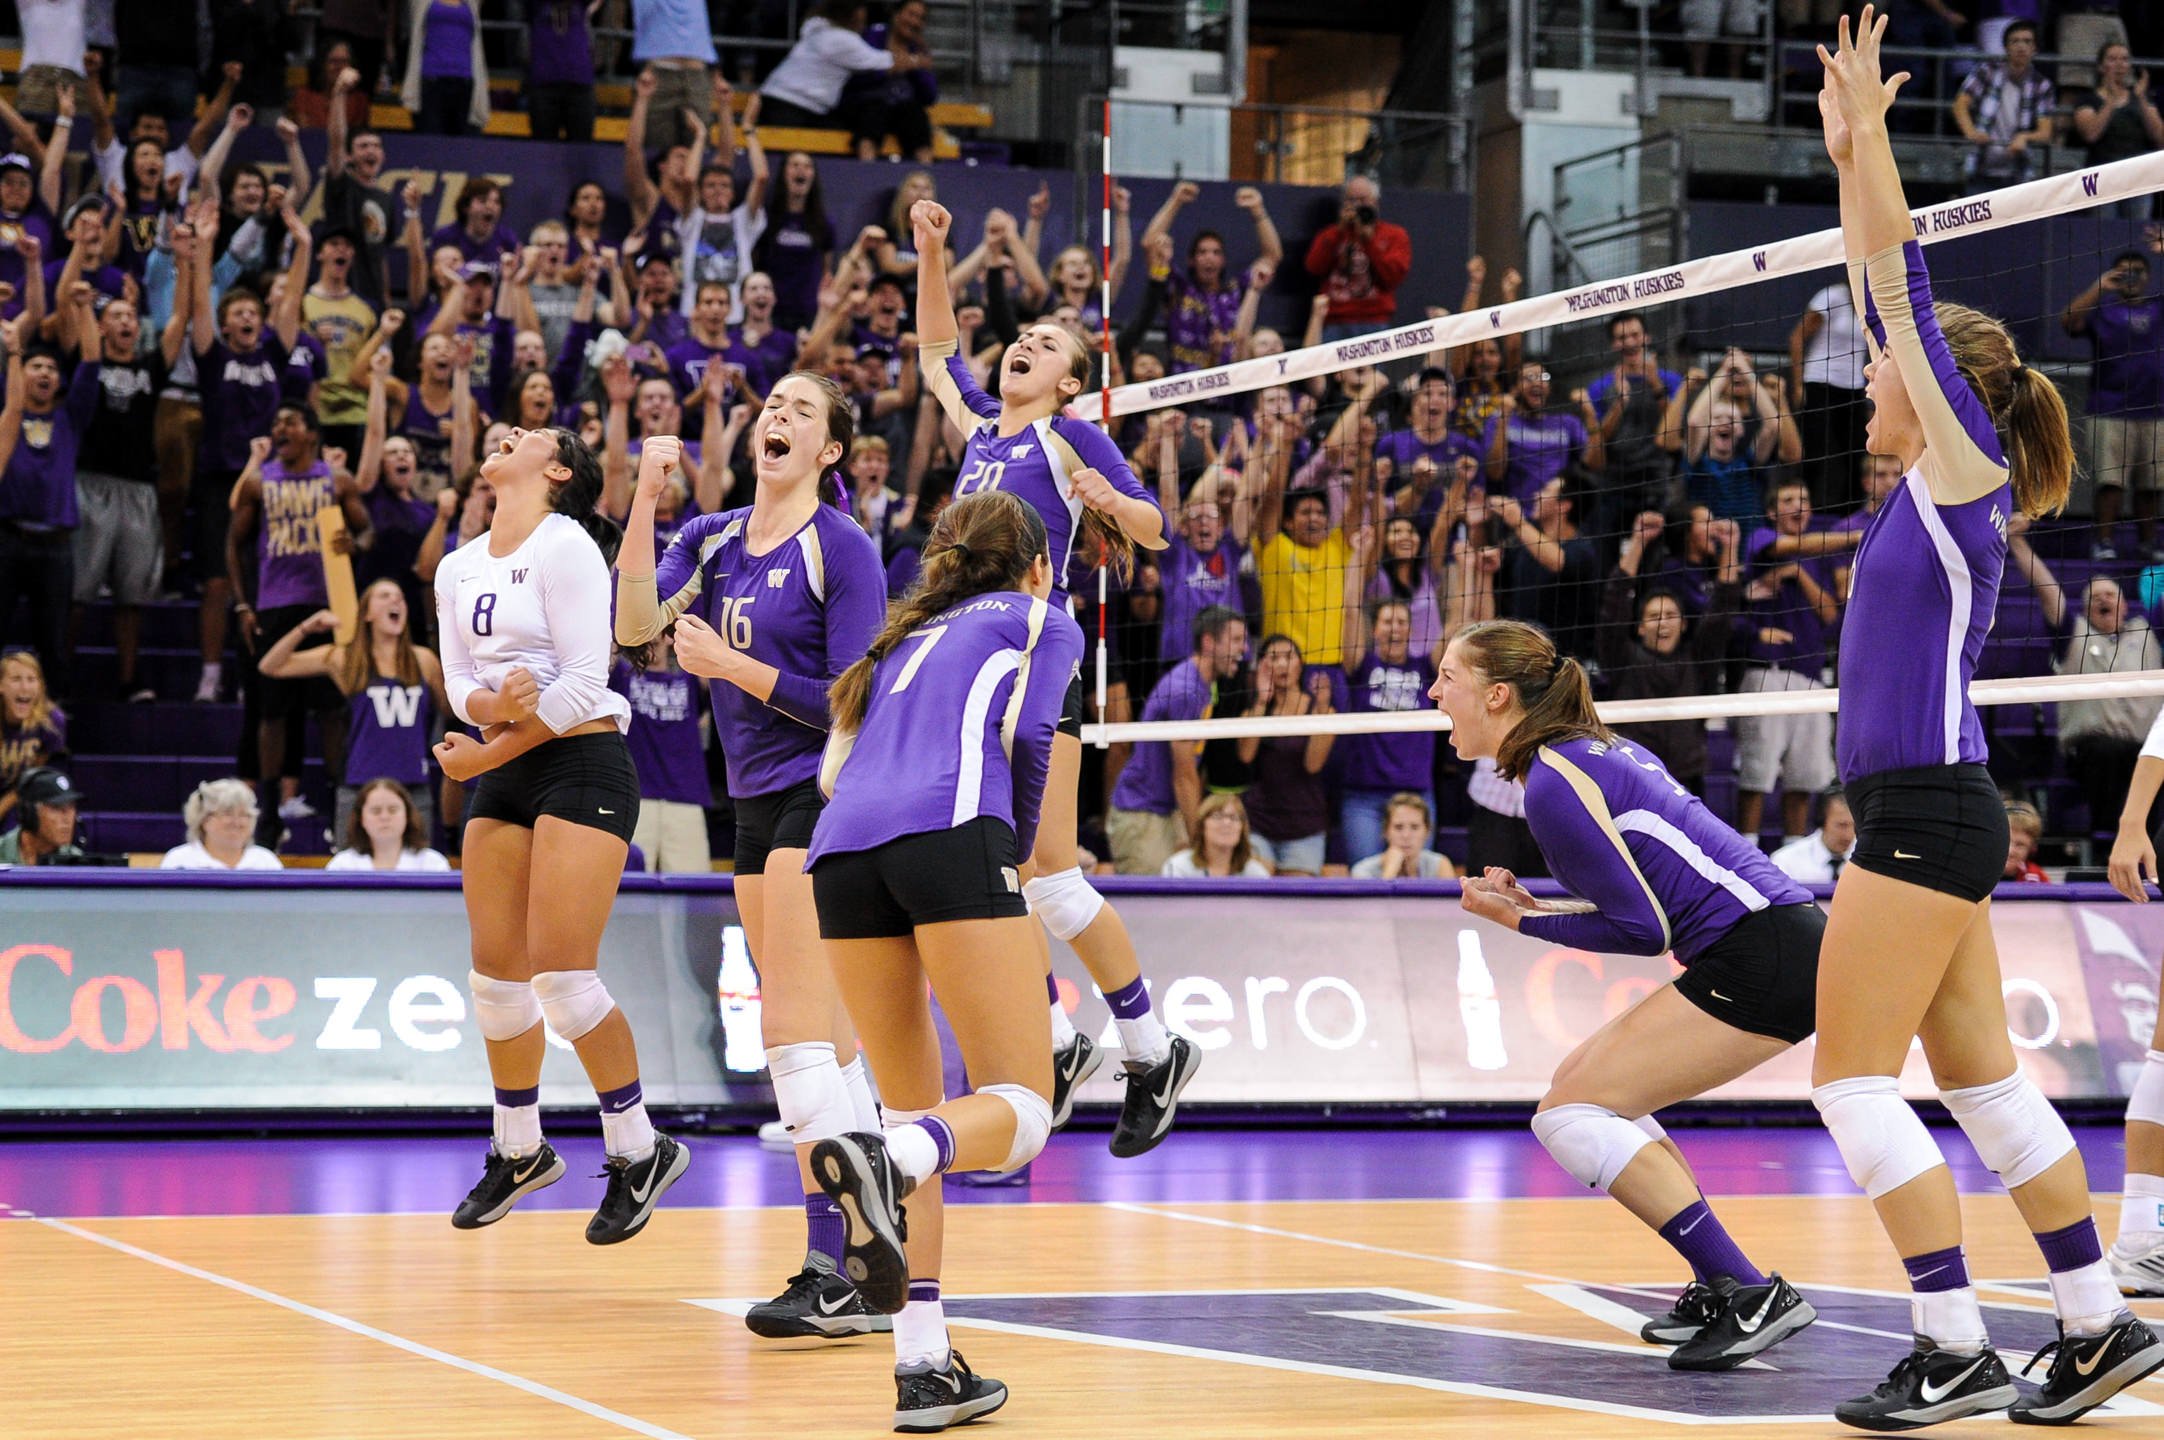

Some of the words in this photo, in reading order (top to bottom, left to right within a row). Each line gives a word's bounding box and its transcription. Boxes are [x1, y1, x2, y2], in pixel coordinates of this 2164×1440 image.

[2082, 173, 2099, 196] W
[1932, 200, 1992, 231] HUSKIES
[1753, 251, 1767, 272] W
[1565, 283, 1630, 313] WASHINGTON
[1634, 271, 1685, 298] HUSKIES
[1336, 337, 1392, 361] WASHINGTON
[1395, 326, 1434, 349] HUSKIES
[1011, 444, 1035, 459] W
[955, 460, 1007, 500] 20
[511, 567, 529, 585] W
[767, 568, 791, 589] W
[472, 593, 497, 637] 8
[721, 595, 756, 650] 16
[924, 600, 1012, 625] INGTON
[889, 624, 948, 695] 7
[366, 685, 423, 729] W
[0, 943, 298, 1054] Coke
